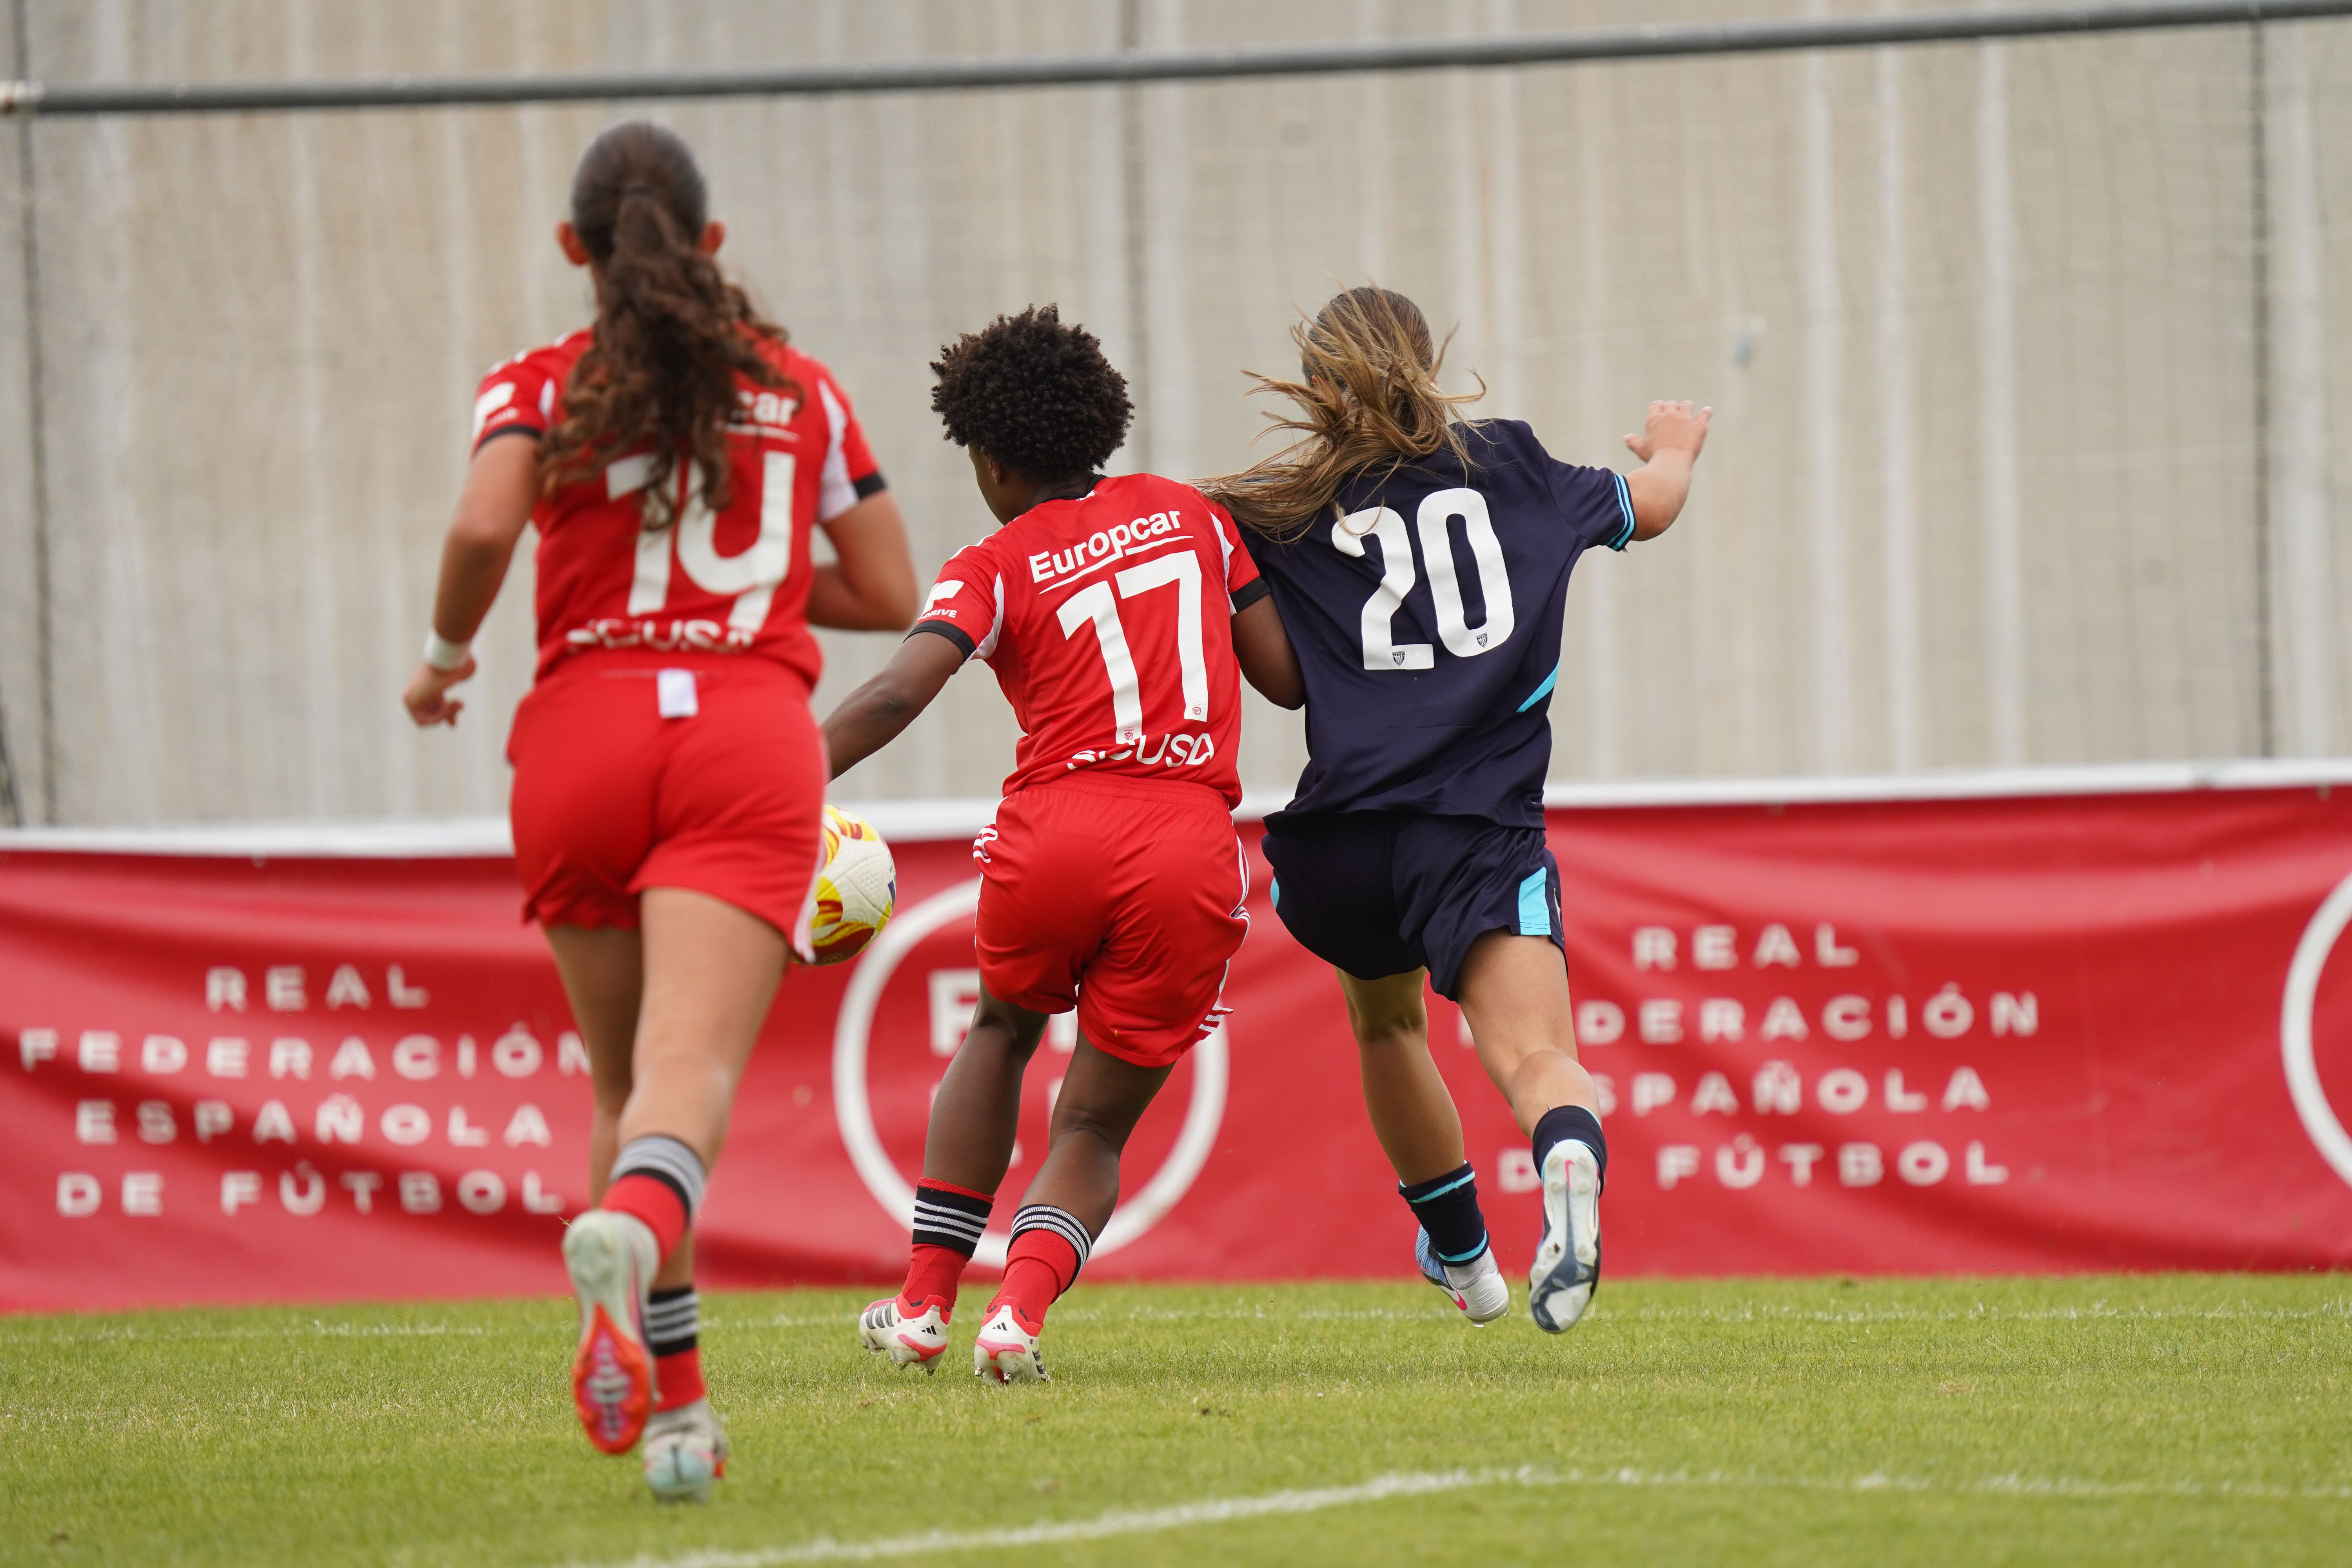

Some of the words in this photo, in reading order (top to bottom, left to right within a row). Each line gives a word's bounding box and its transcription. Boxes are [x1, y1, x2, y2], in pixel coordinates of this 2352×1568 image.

[1029, 510, 1181, 583] Europcar
[1332, 488, 1514, 670] 20
[1056, 550, 1208, 744] 17
[1632, 923, 1860, 972] REAL
[206, 964, 430, 1013] REAL
[76, 1093, 553, 1147] ESPAÑOLA
[56, 1170, 164, 1218] DE
[220, 1159, 565, 1217] FÚTBOL
[1657, 1133, 2010, 1191] FÚTBOL
